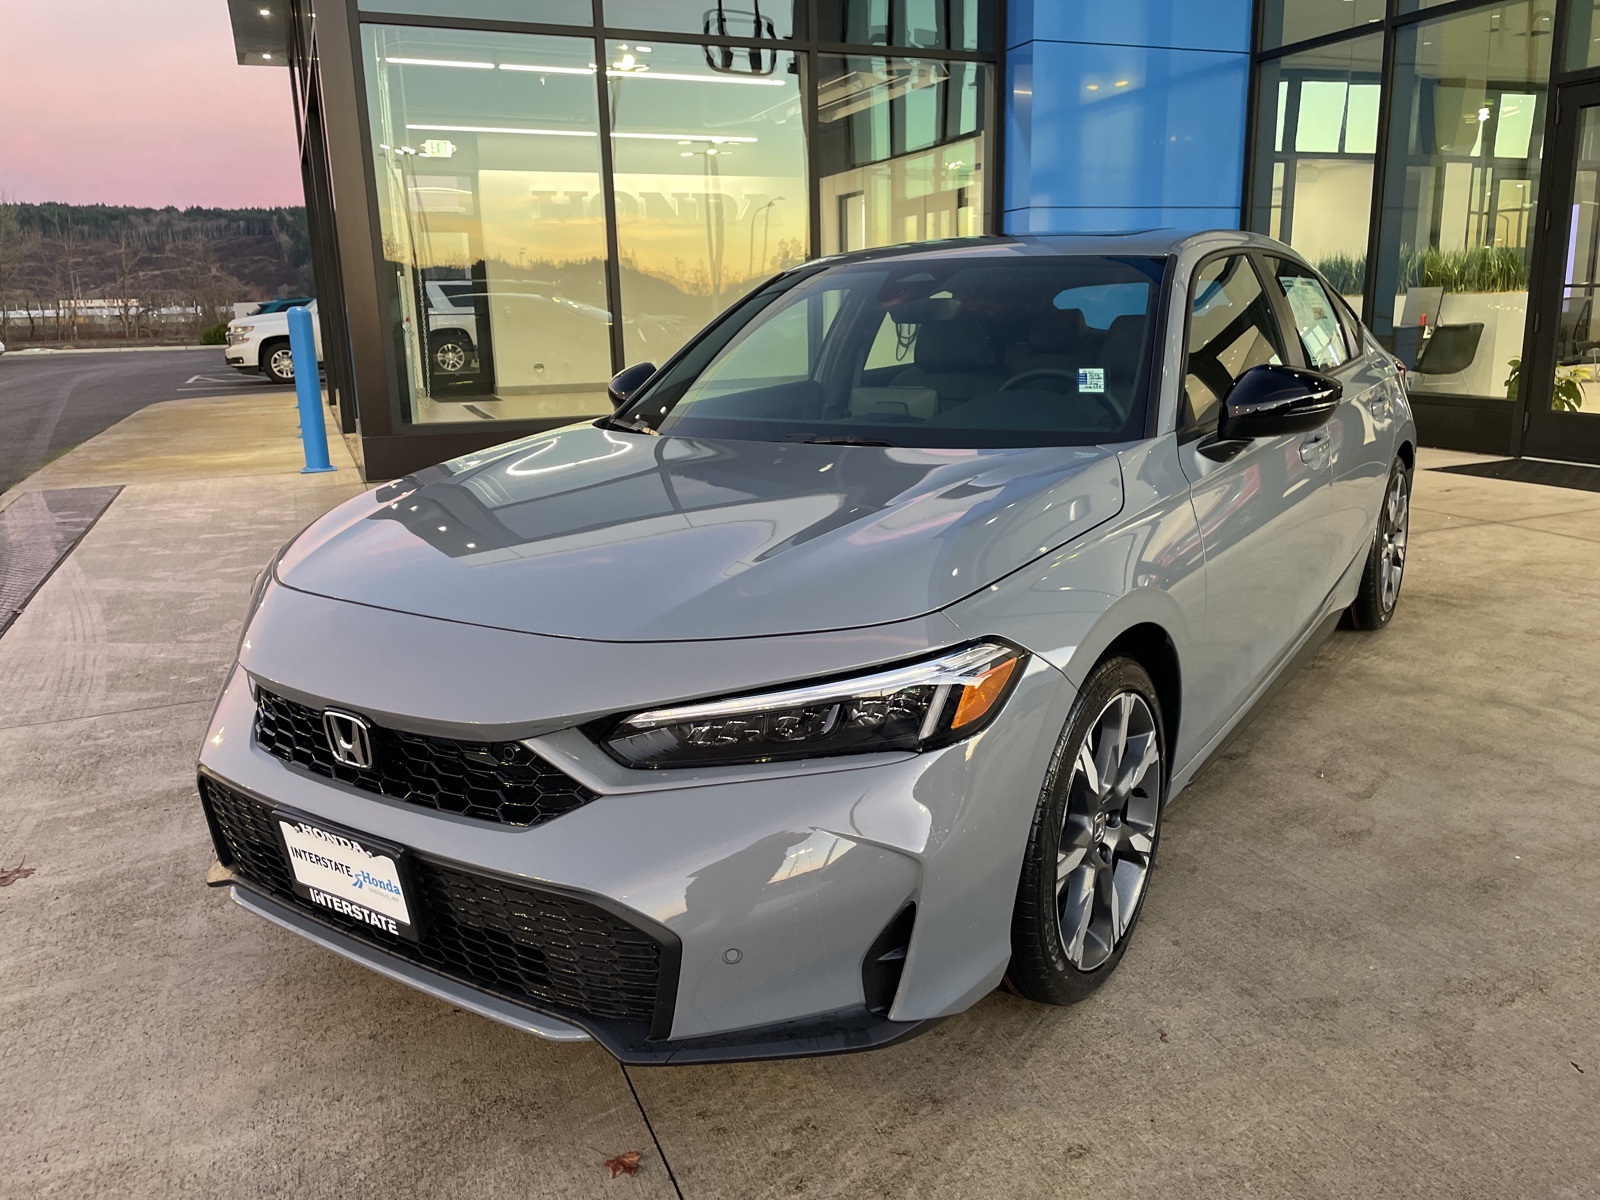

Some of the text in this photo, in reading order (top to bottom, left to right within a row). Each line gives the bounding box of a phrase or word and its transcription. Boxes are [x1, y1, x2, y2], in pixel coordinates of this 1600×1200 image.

[531, 190, 785, 225] HONDA
[298, 822, 367, 853] HONDA
[290, 845, 354, 878] INTERSTATE
[360, 870, 401, 895] Honda
[309, 887, 399, 936] INTERSTATE
